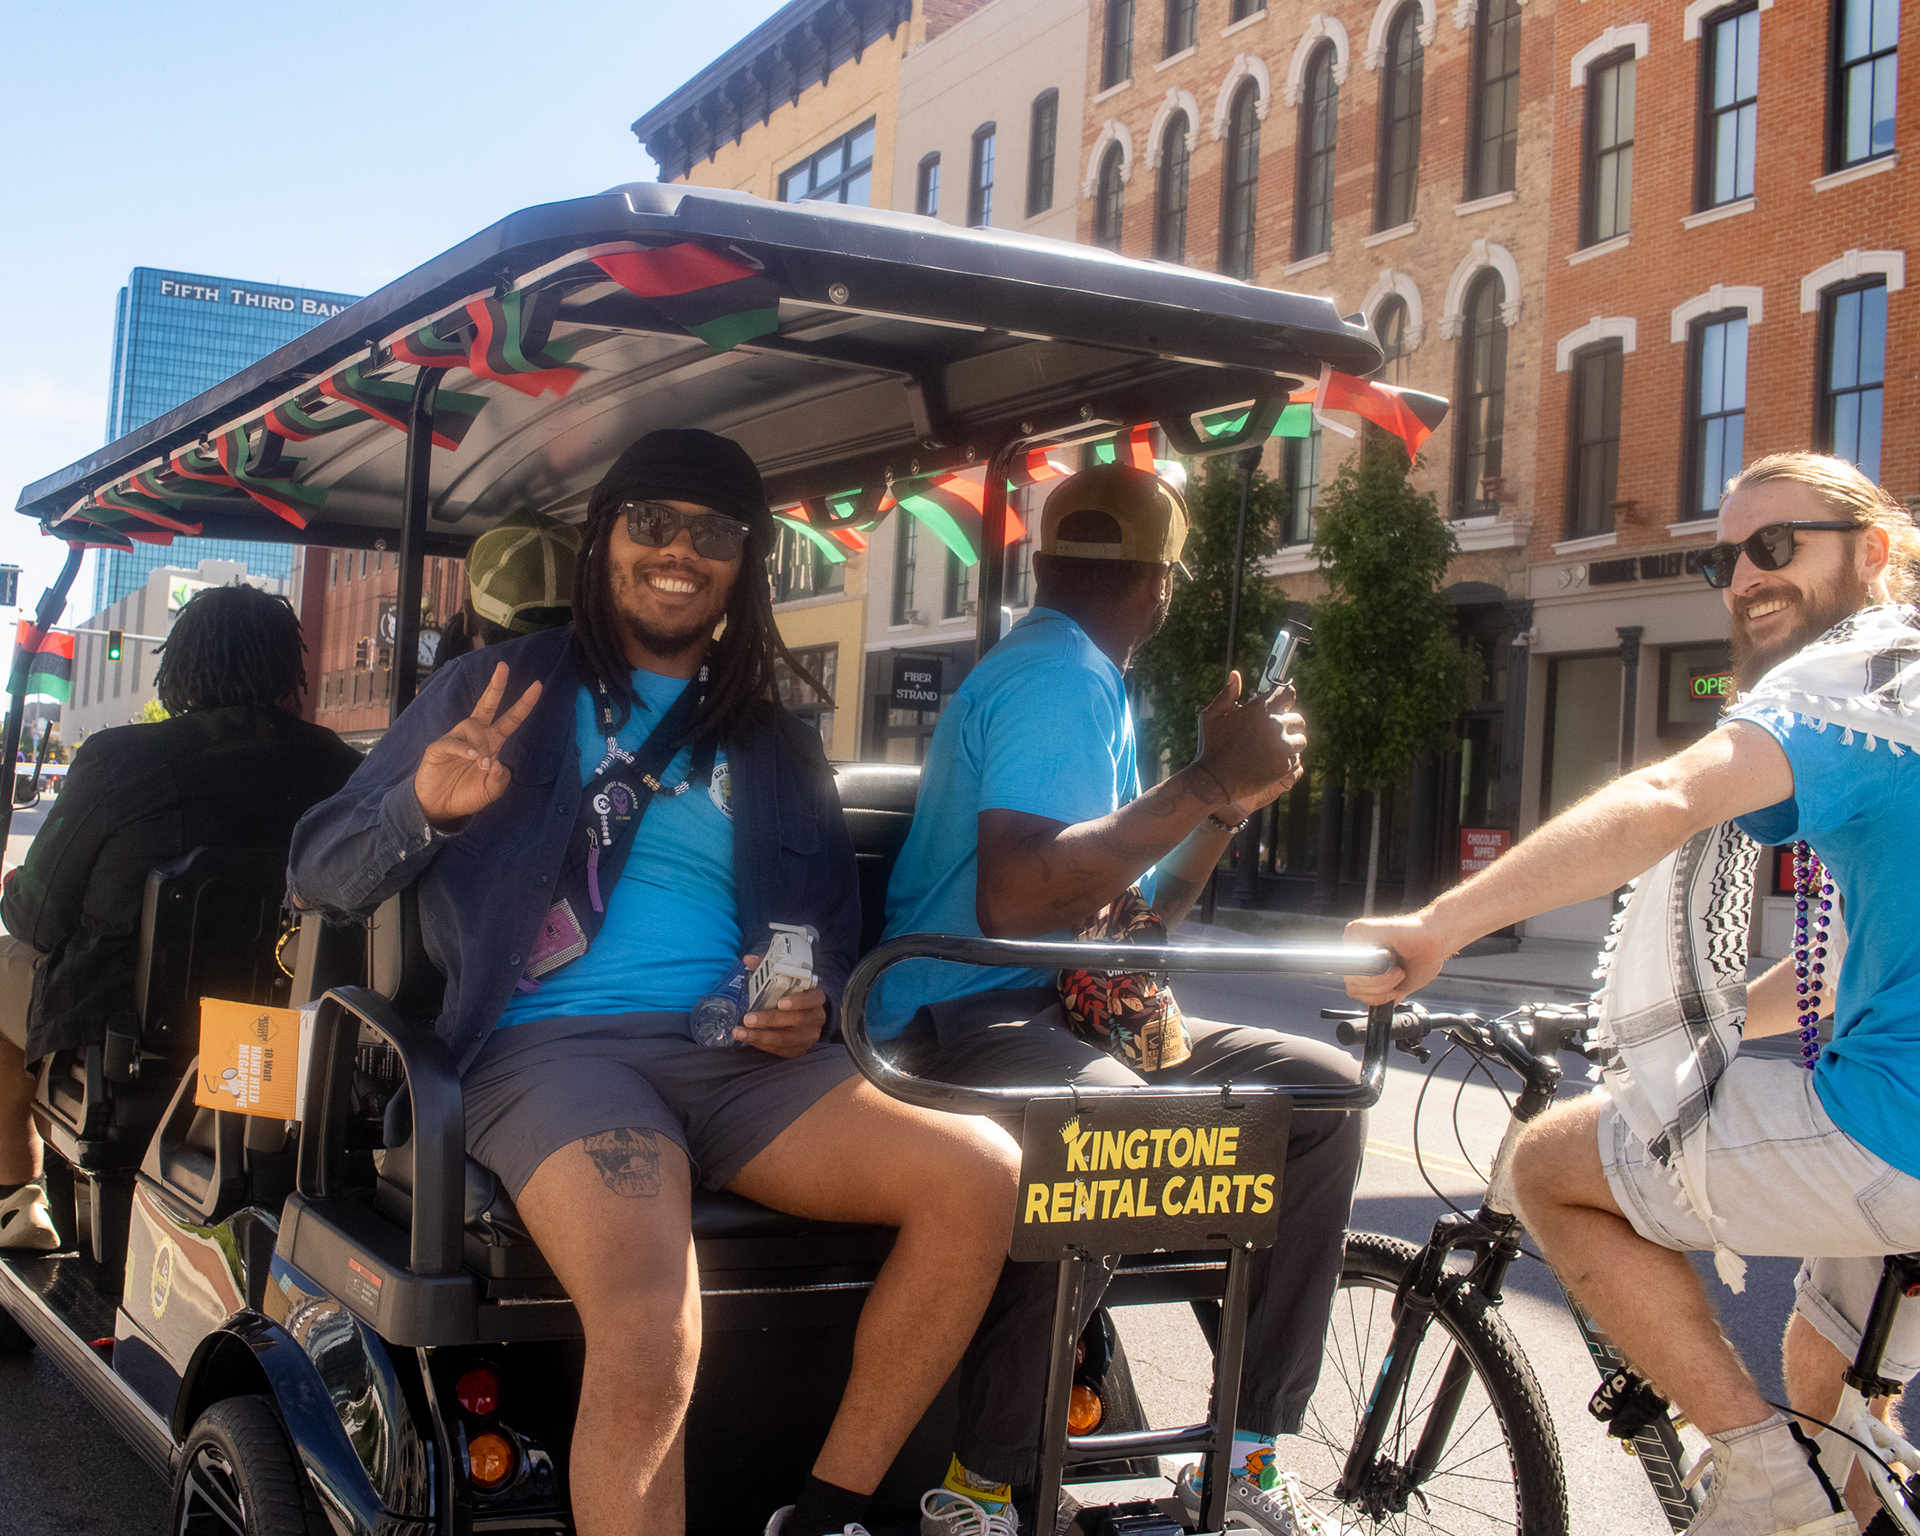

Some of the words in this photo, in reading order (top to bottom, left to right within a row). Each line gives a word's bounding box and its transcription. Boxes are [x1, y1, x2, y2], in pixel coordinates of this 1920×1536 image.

[160, 279, 220, 302] FIFTH
[231, 289, 295, 312] THIRD
[302, 298, 348, 318] BAN
[904, 671, 932, 683] FIBER
[1694, 676, 1729, 696] OPE
[896, 688, 938, 701] STRAND
[1467, 833, 1502, 846] CHOCOLATE
[1473, 846, 1496, 858] DIPPED
[262, 1015, 270, 1042] WESTERN
[250, 1045, 262, 1076] HAND
[264, 1048, 274, 1059] 10
[236, 1043, 250, 1109] MEGAPHONE
[263, 1060, 273, 1083] Watt
[248, 1076, 261, 1104] HELD
[1066, 1127, 1240, 1173] KINGTONE
[1024, 1177, 1158, 1224] RENTAL
[1161, 1173, 1276, 1217] CARTS
